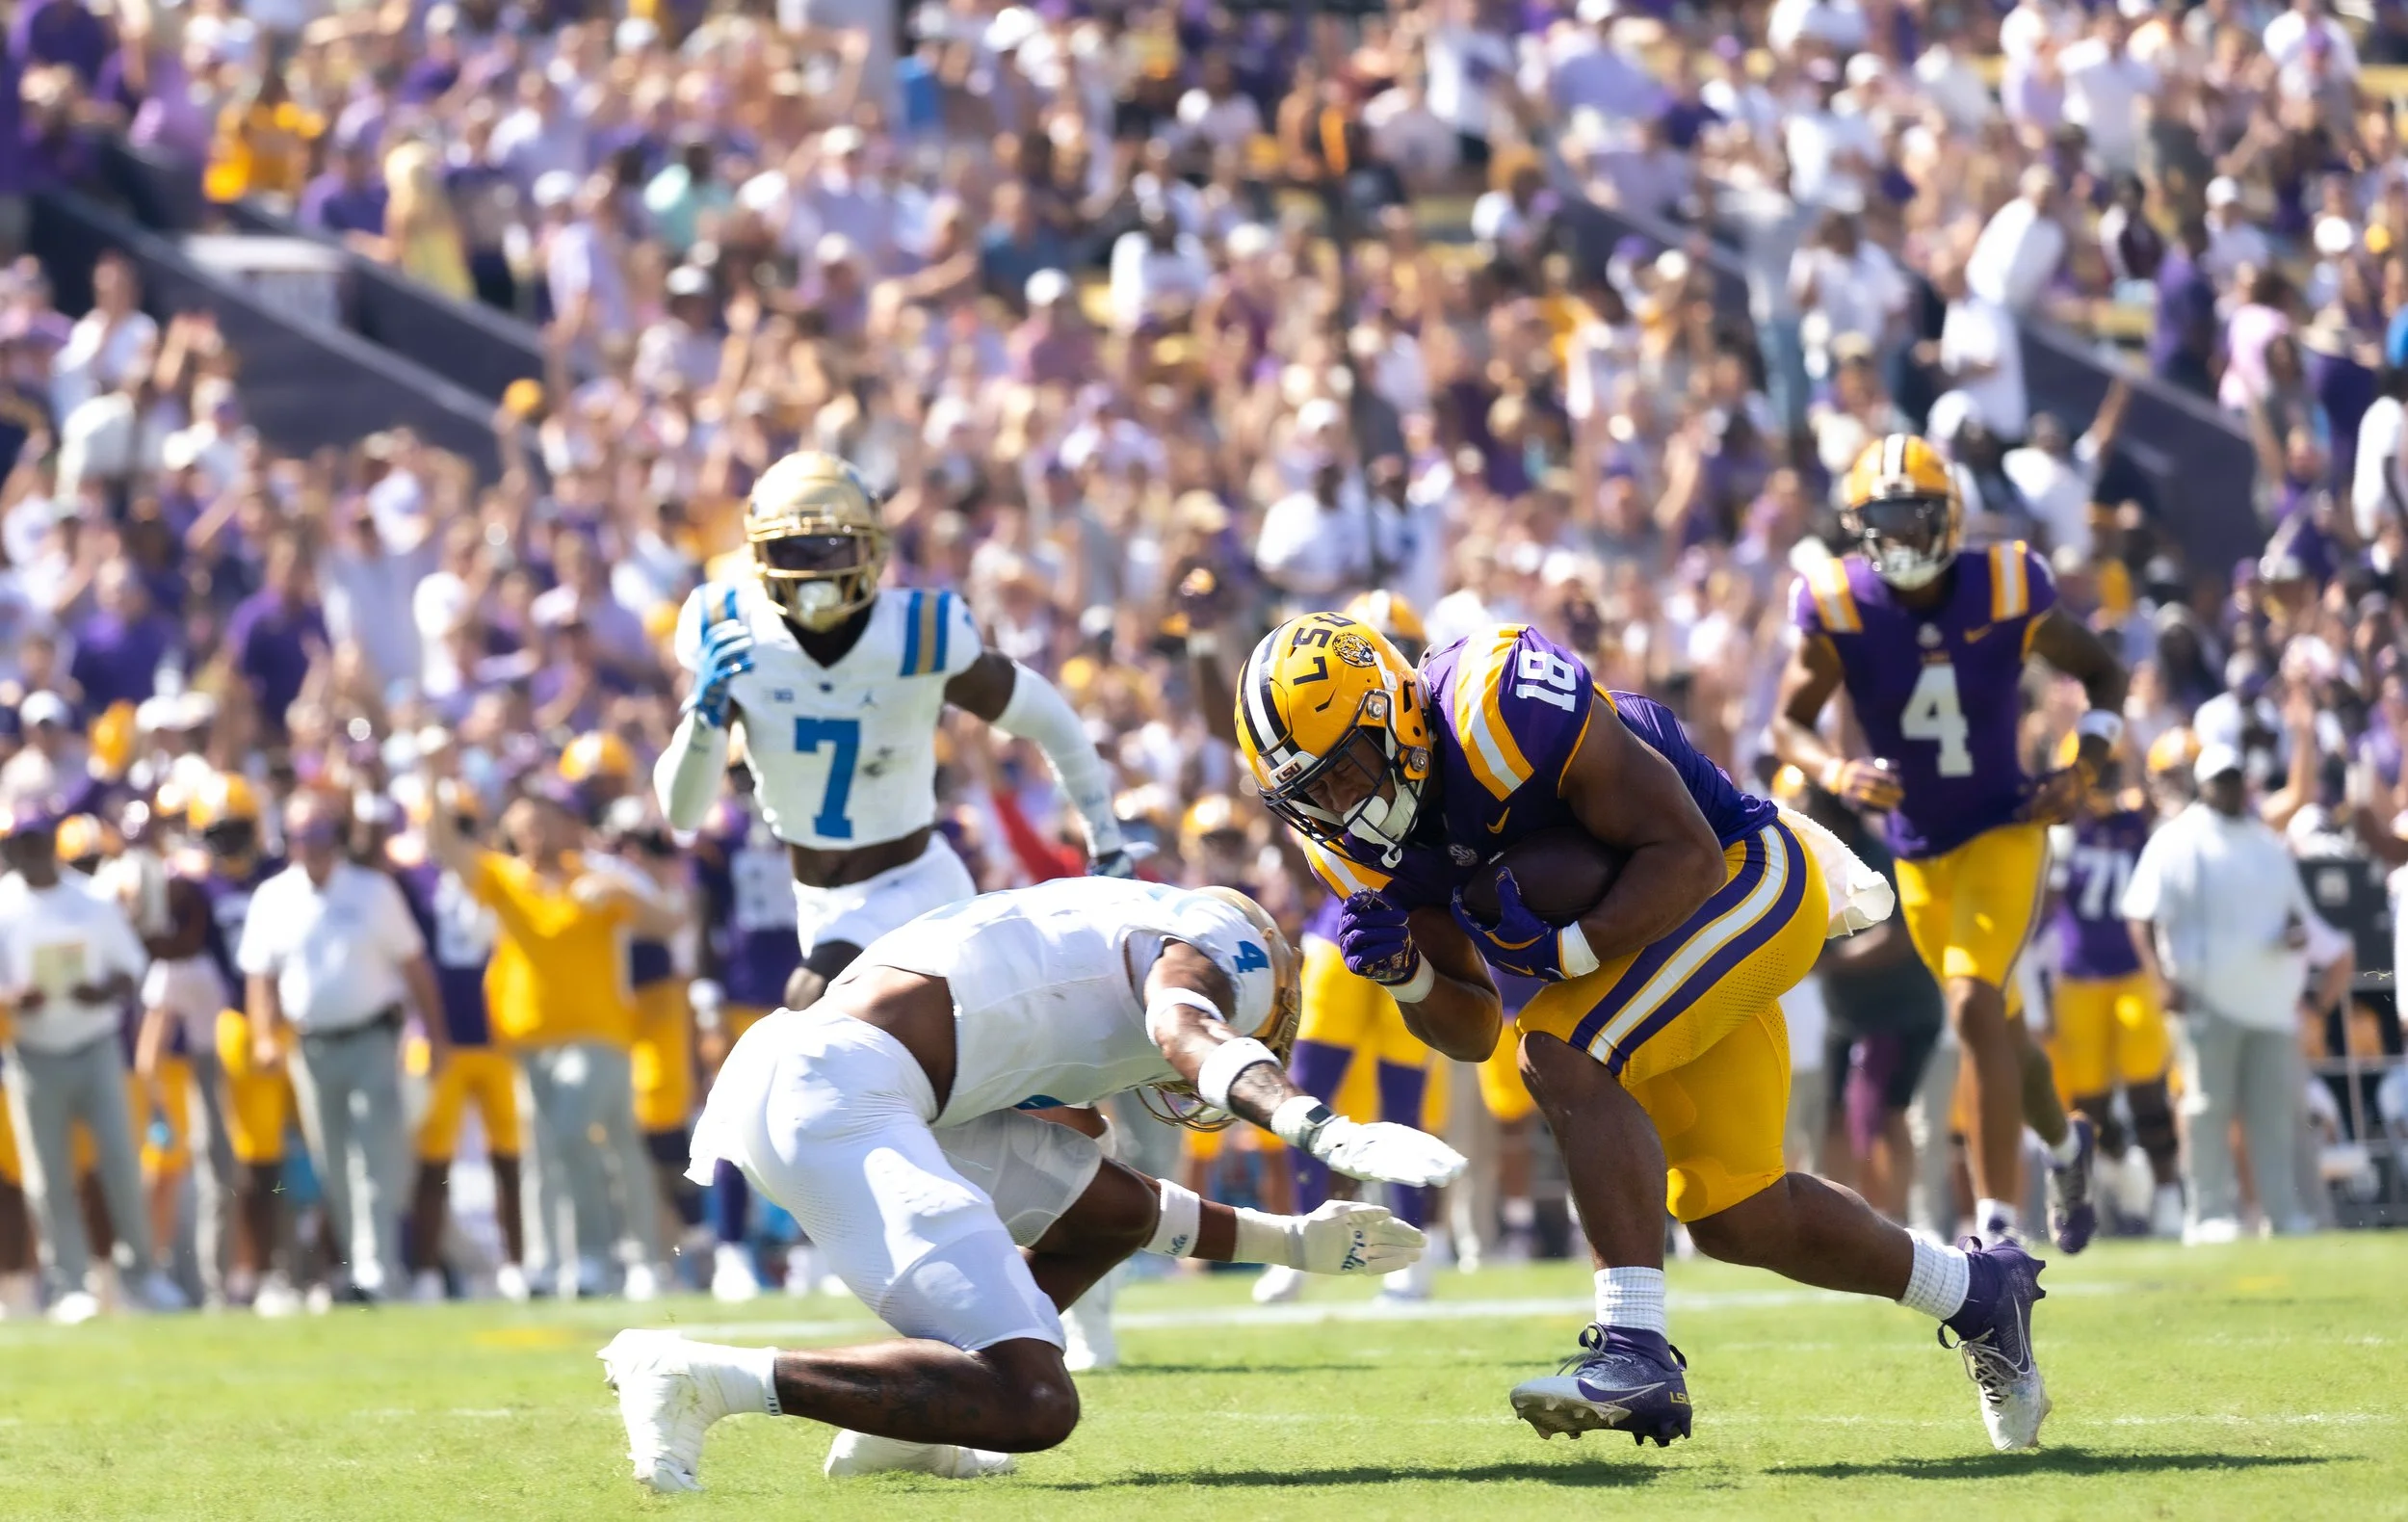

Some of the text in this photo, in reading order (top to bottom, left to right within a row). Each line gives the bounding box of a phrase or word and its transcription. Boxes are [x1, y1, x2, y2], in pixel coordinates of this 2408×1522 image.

[1292, 613, 1356, 686] LSU
[1516, 649, 1577, 713] 18
[1899, 661, 1973, 778] 4
[794, 717, 861, 839] 7
[1274, 760, 1303, 784] LSU
[1232, 940, 1269, 973] 4
